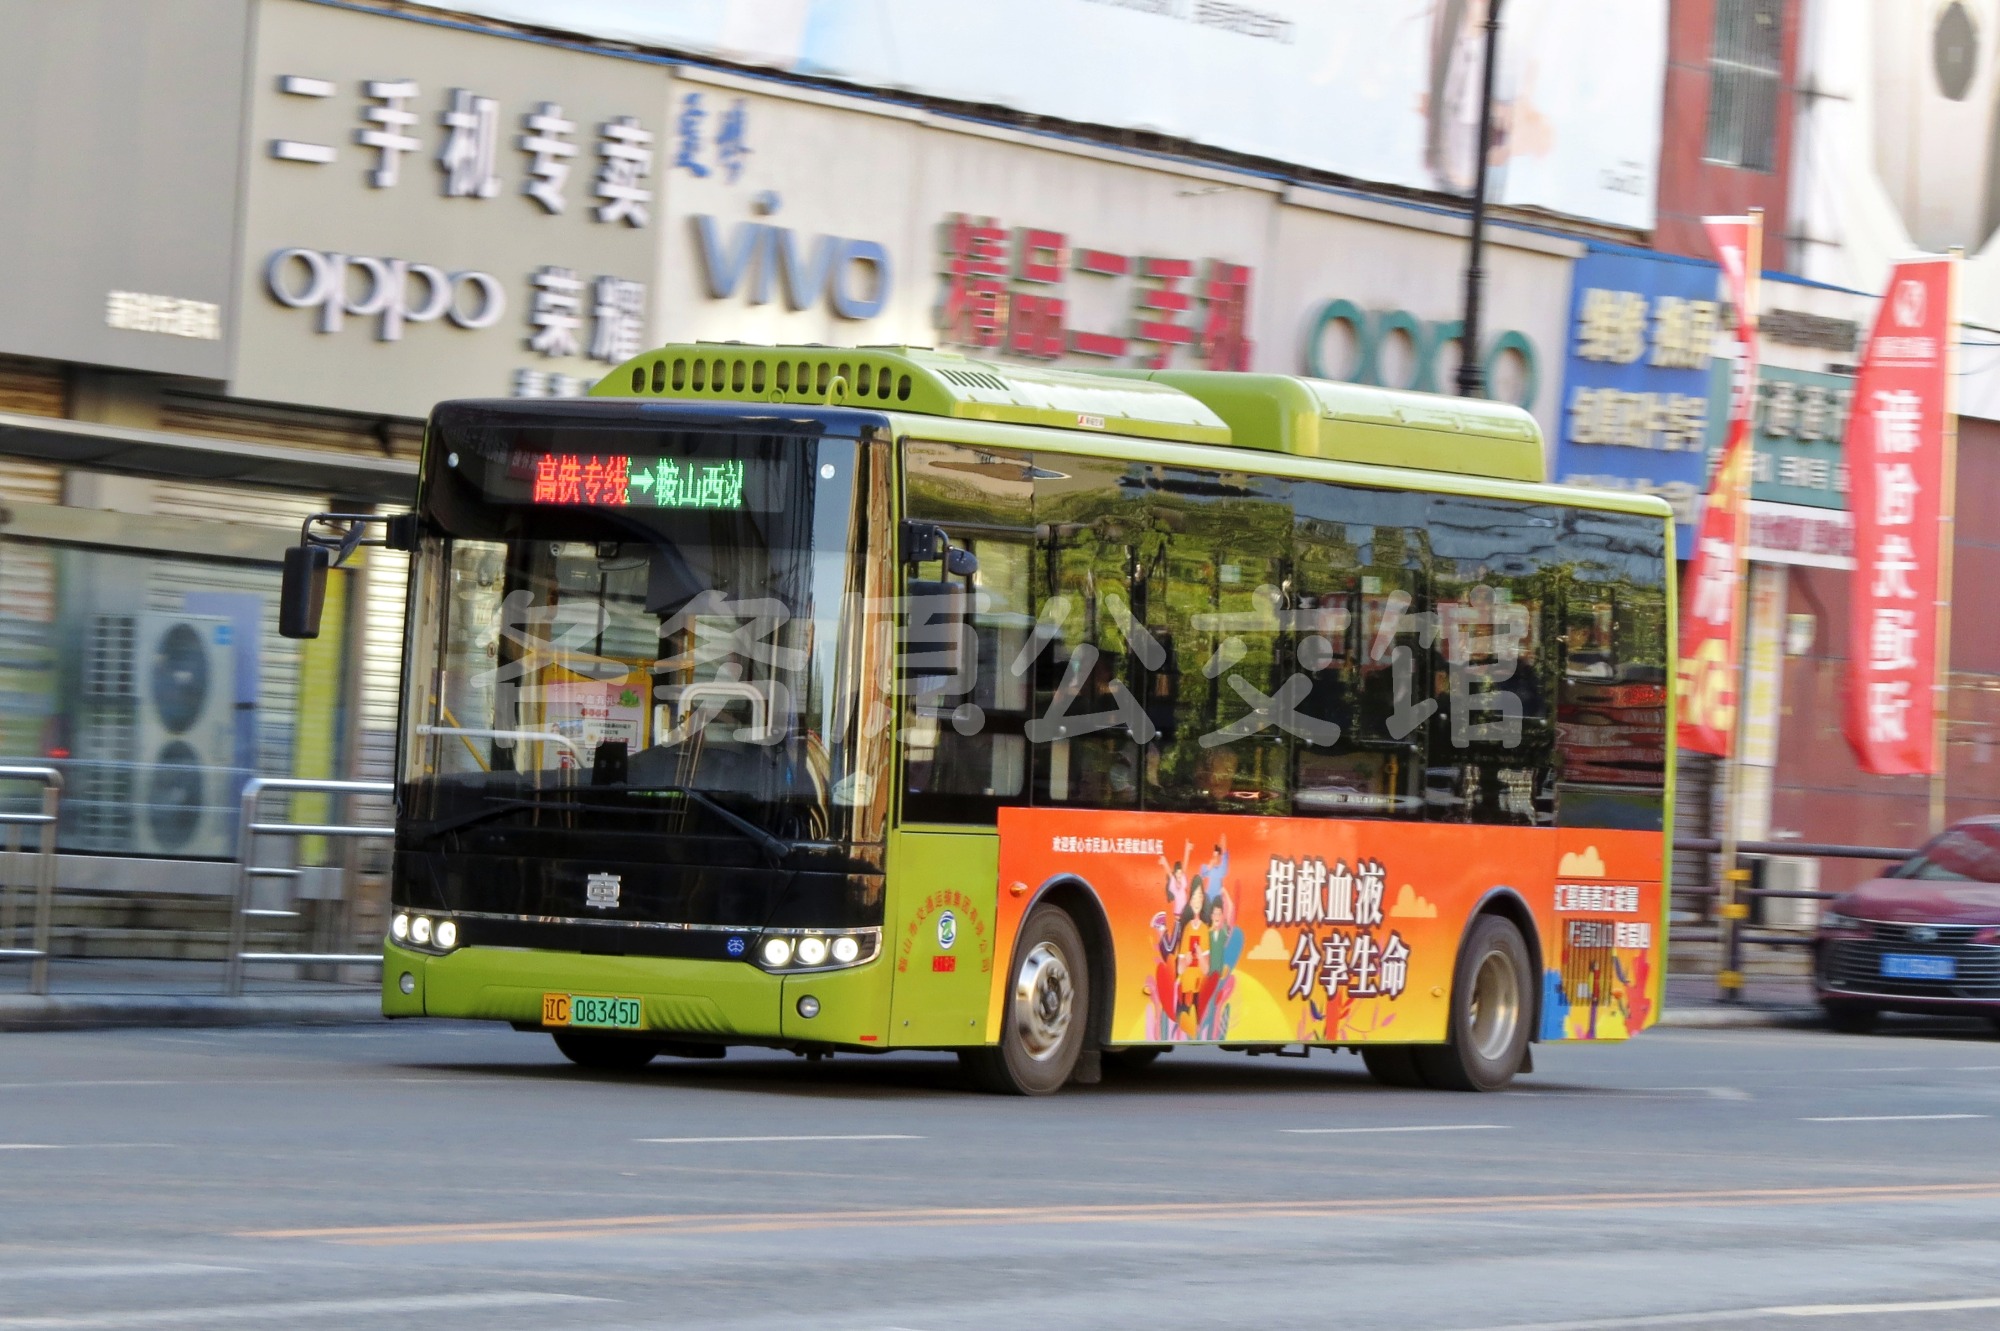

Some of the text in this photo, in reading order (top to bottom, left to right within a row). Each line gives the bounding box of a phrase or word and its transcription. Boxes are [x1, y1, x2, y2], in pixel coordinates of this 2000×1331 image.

[270, 73, 652, 228] 二手机专卖
[688, 190, 893, 320] vivo
[530, 265, 646, 364] 荣耀
[534, 454, 632, 504] 高铁专线
[655, 457, 742, 507] 鞍山西站
[1264, 857, 1386, 926] 捐献血液
[1288, 931, 1410, 998] 分享生命
